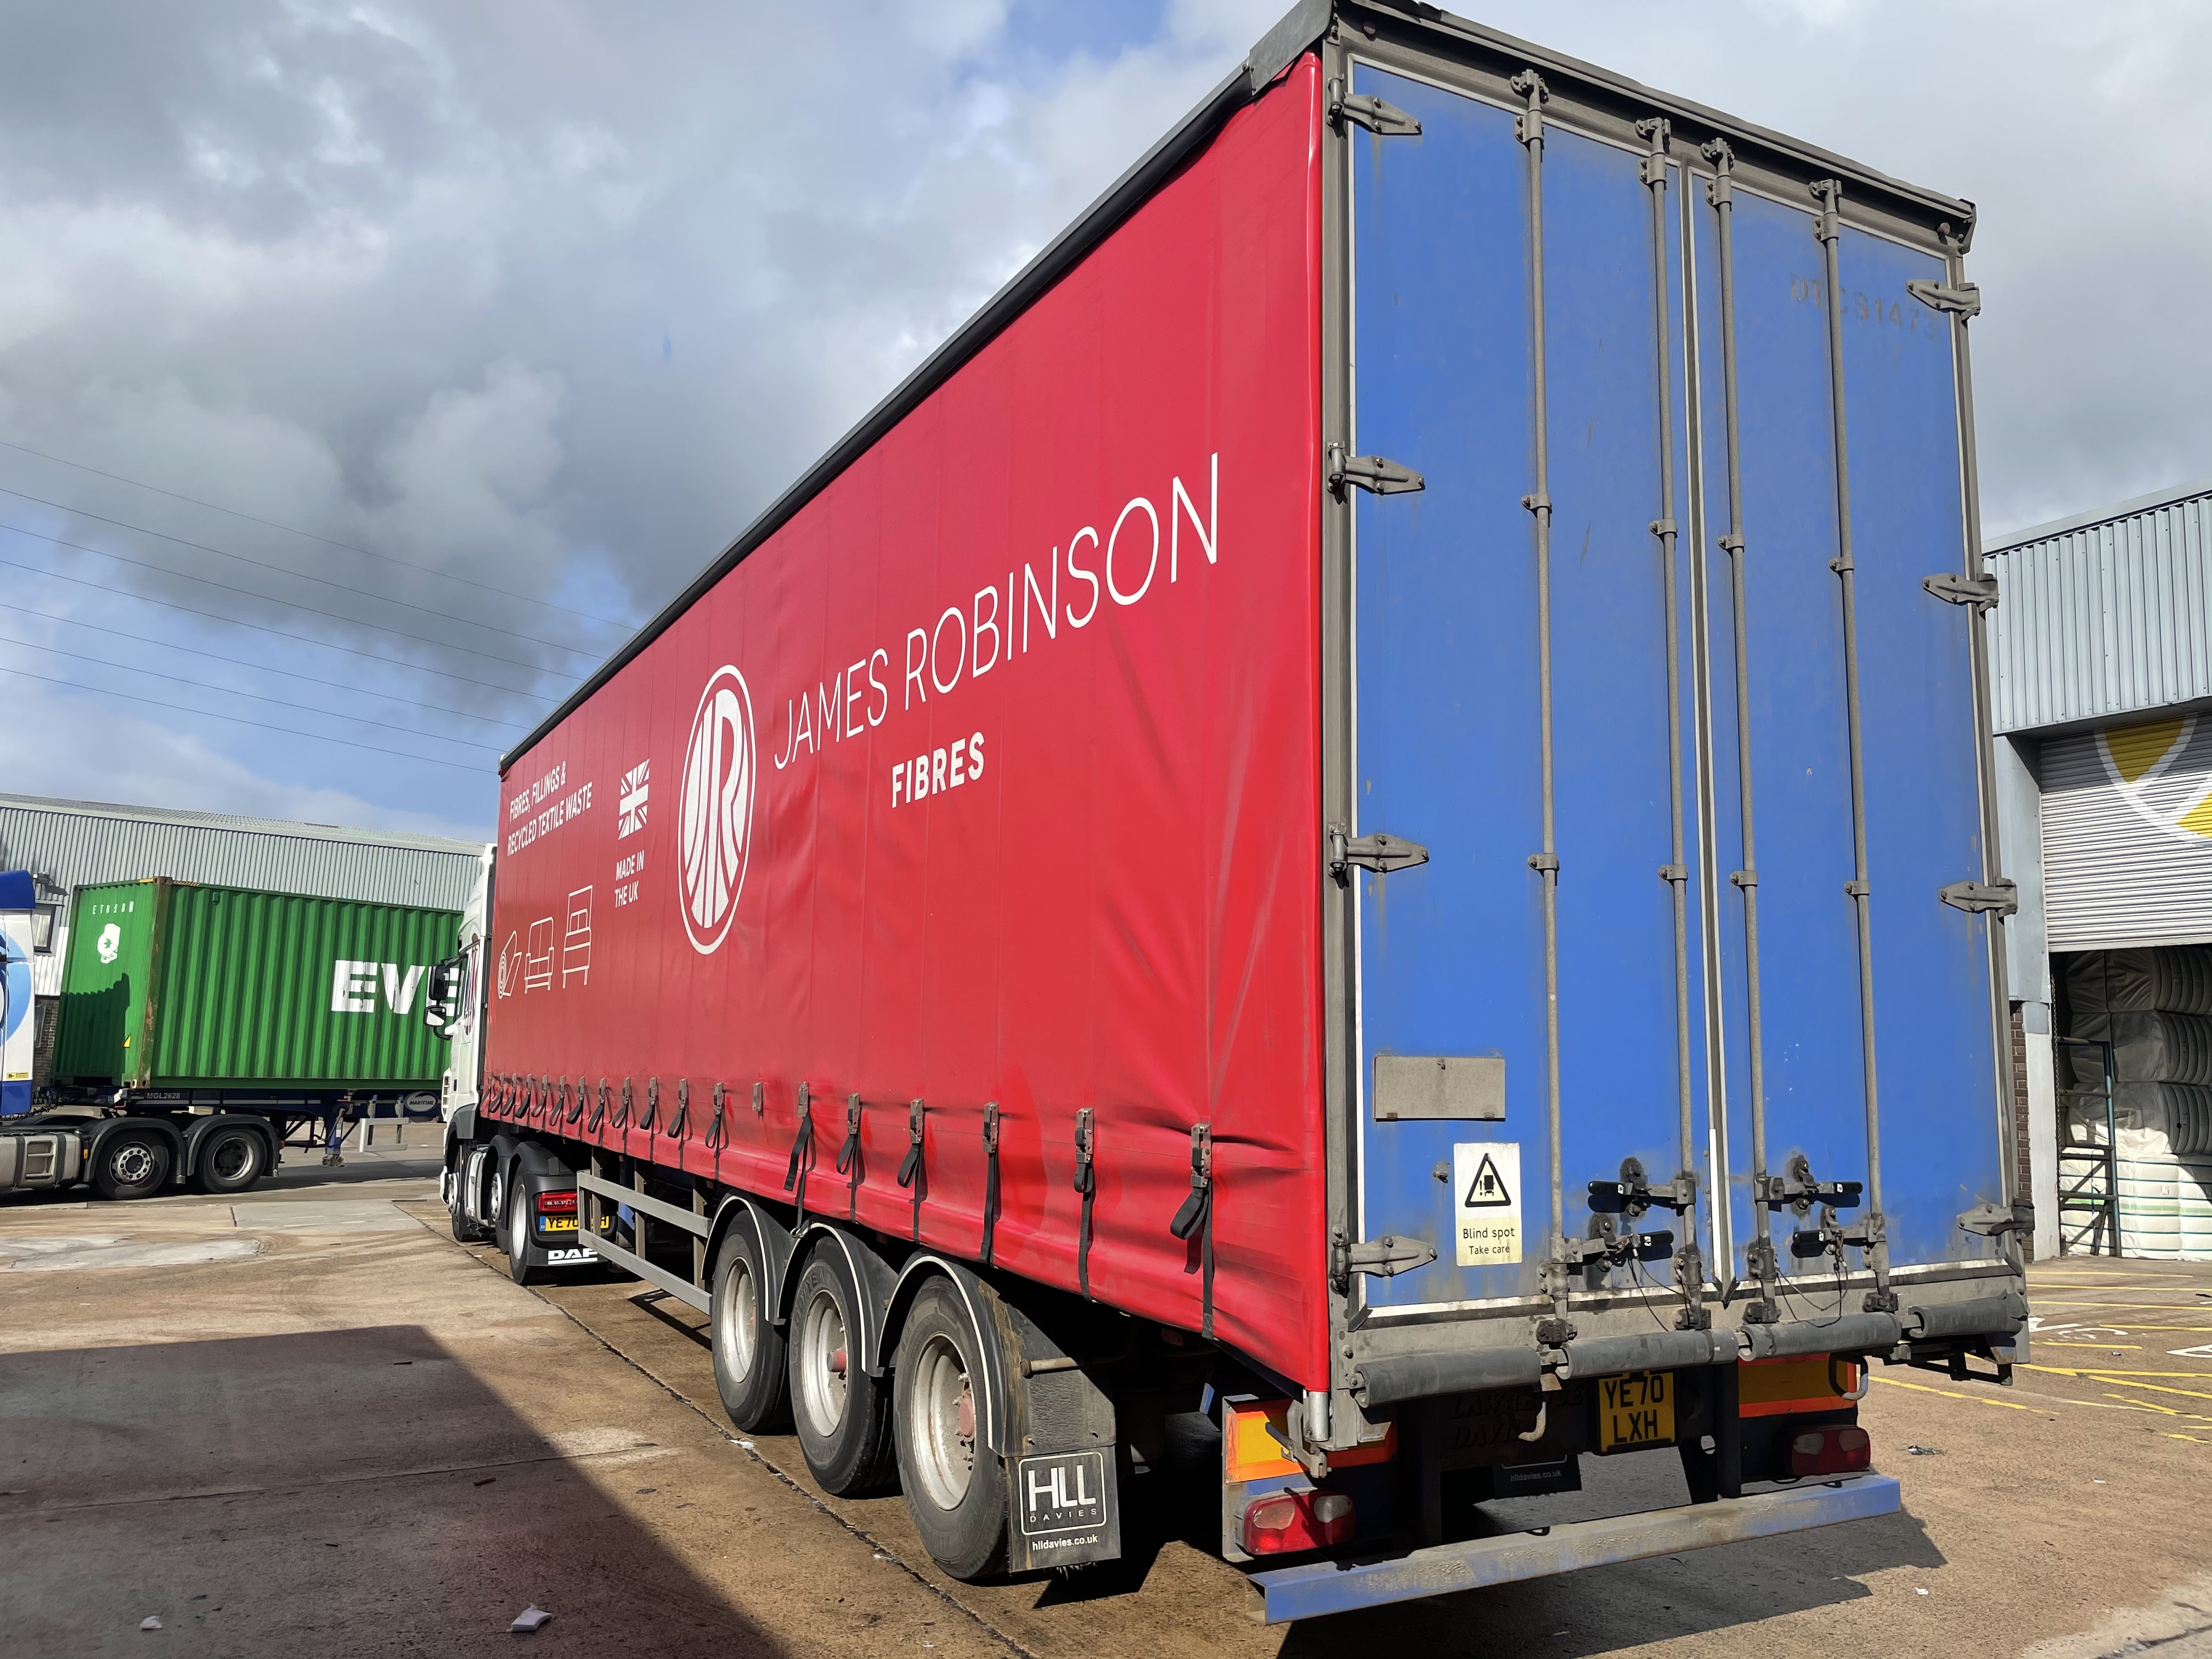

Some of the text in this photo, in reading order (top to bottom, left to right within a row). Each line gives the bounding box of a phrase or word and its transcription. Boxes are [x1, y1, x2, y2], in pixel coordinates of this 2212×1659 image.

[774, 452, 1218, 771] JAMES ROBINSON
[891, 731, 985, 809] FIBRES
[510, 760, 566, 822] FIBRES, FILLINGS &
[507, 782, 592, 857] RECYCLED TEXTILE WASTE
[616, 850, 645, 881] MADE IN
[615, 881, 639, 908] THE UK
[1463, 1227, 1515, 1240] Blind spot
[548, 1248, 598, 1260] DAF
[1469, 1245, 1489, 1255] Take
[1604, 1375, 1664, 1409] YE70
[1613, 1409, 1658, 1441] LXH
[1030, 1508, 1097, 1522] DAVIES
